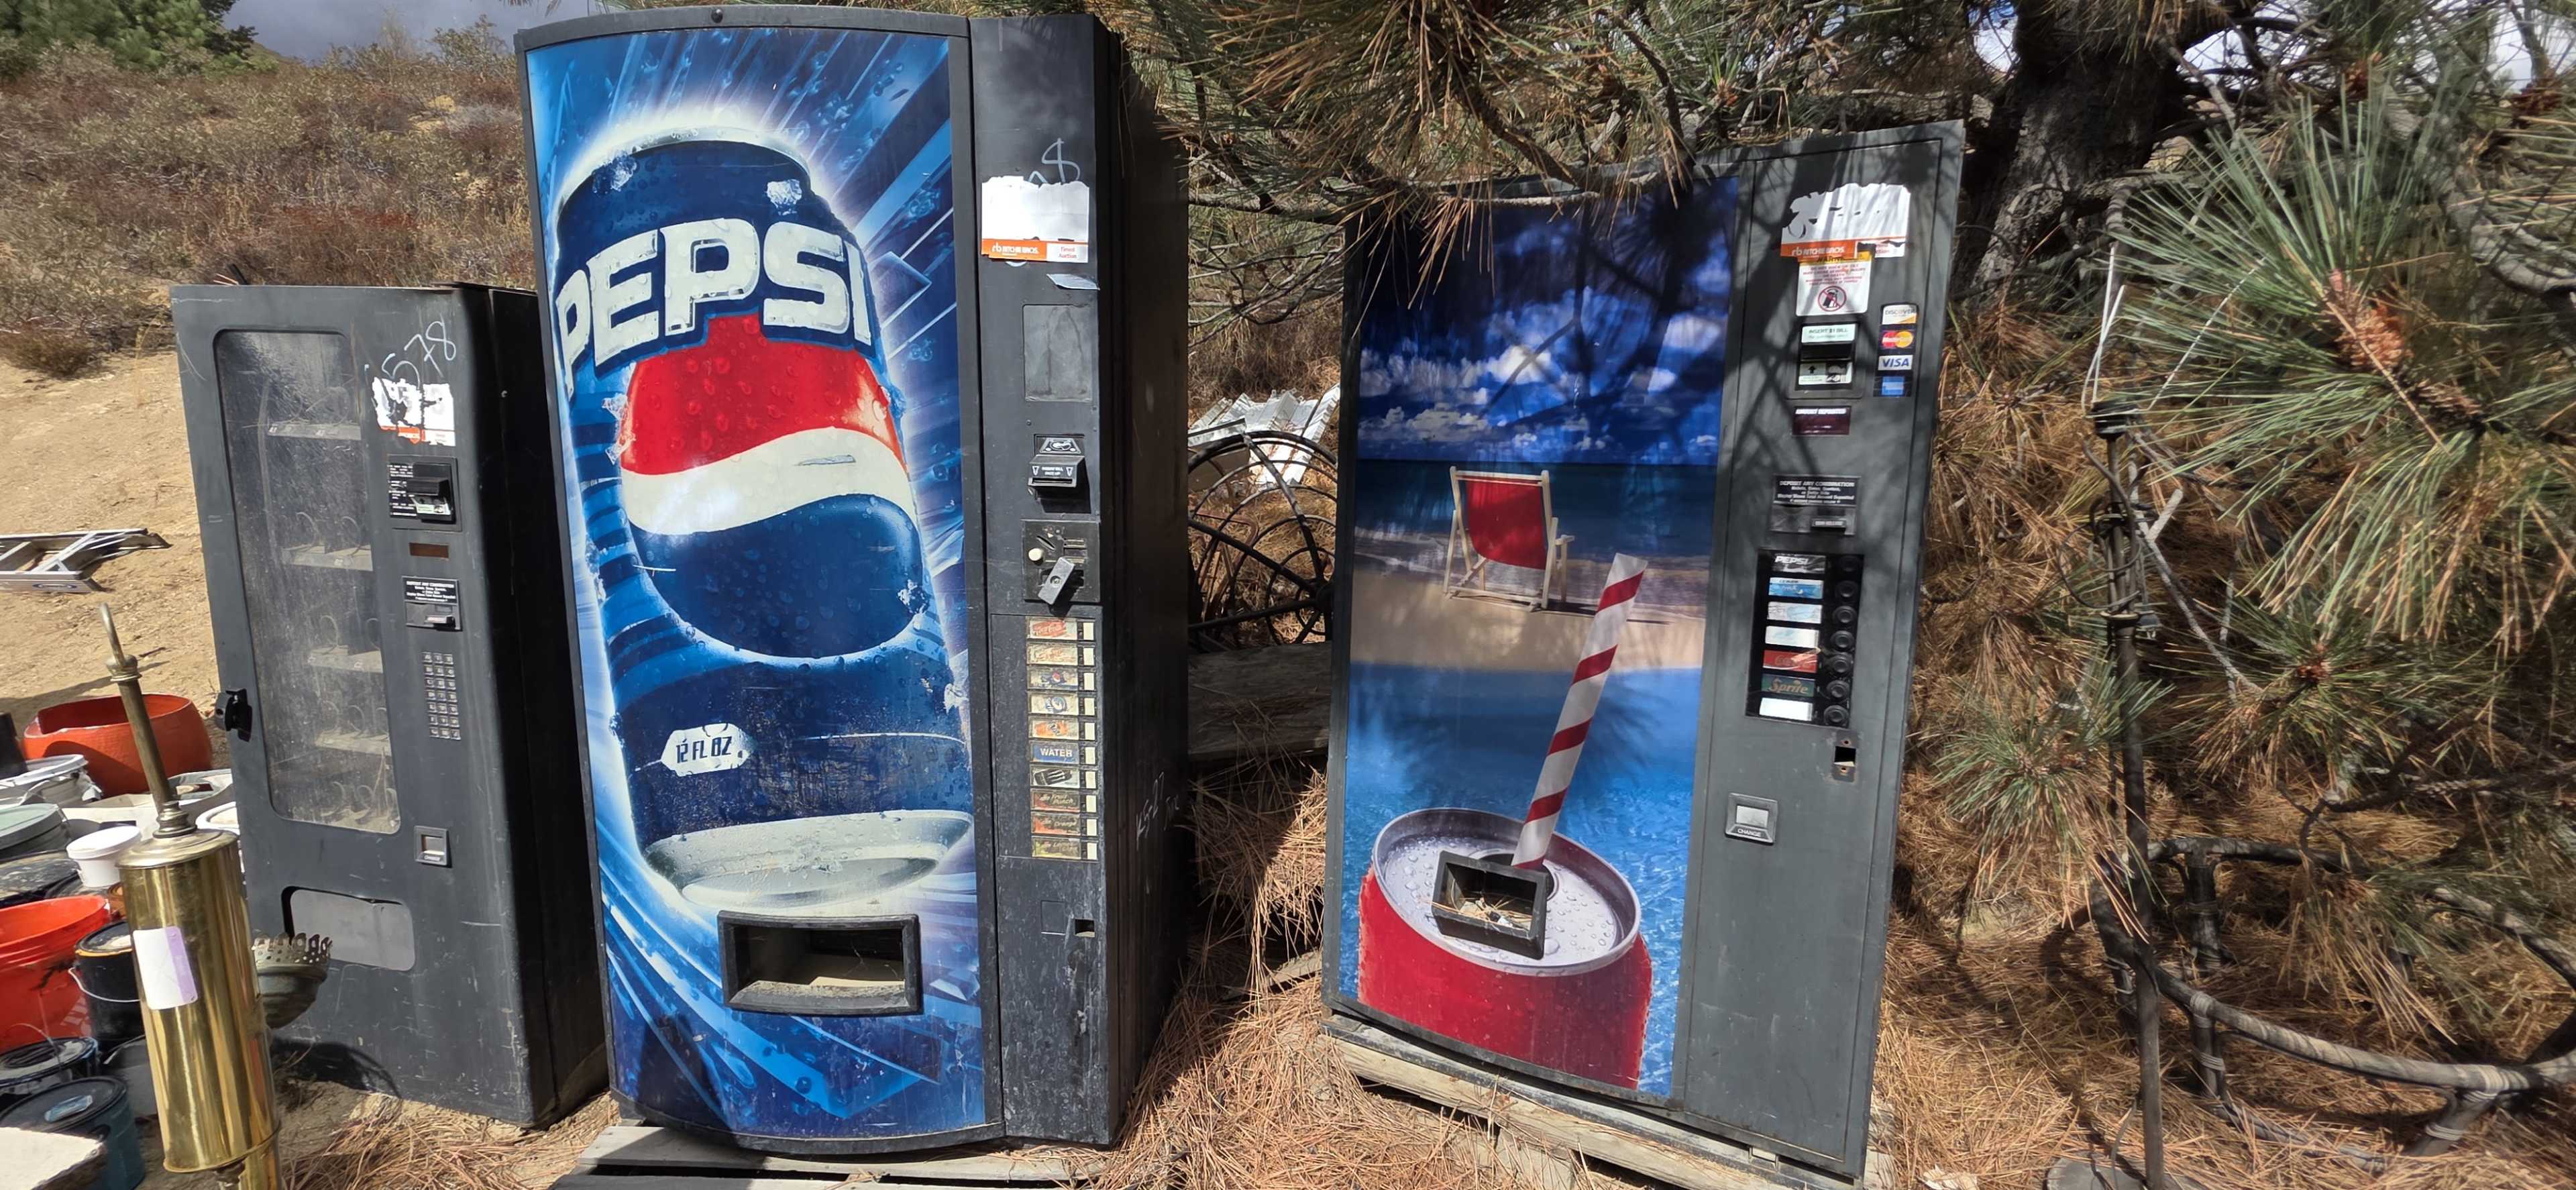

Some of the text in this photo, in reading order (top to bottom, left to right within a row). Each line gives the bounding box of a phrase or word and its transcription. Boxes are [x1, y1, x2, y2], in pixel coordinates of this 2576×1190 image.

[556, 218, 871, 401] PEPSI
[1882, 358, 1910, 368] VISA
[1774, 555, 1809, 565] PEPSI
[1768, 676, 1809, 694] Sprite
[692, 740, 707, 761] FL
[1040, 748, 1073, 757] WATER
